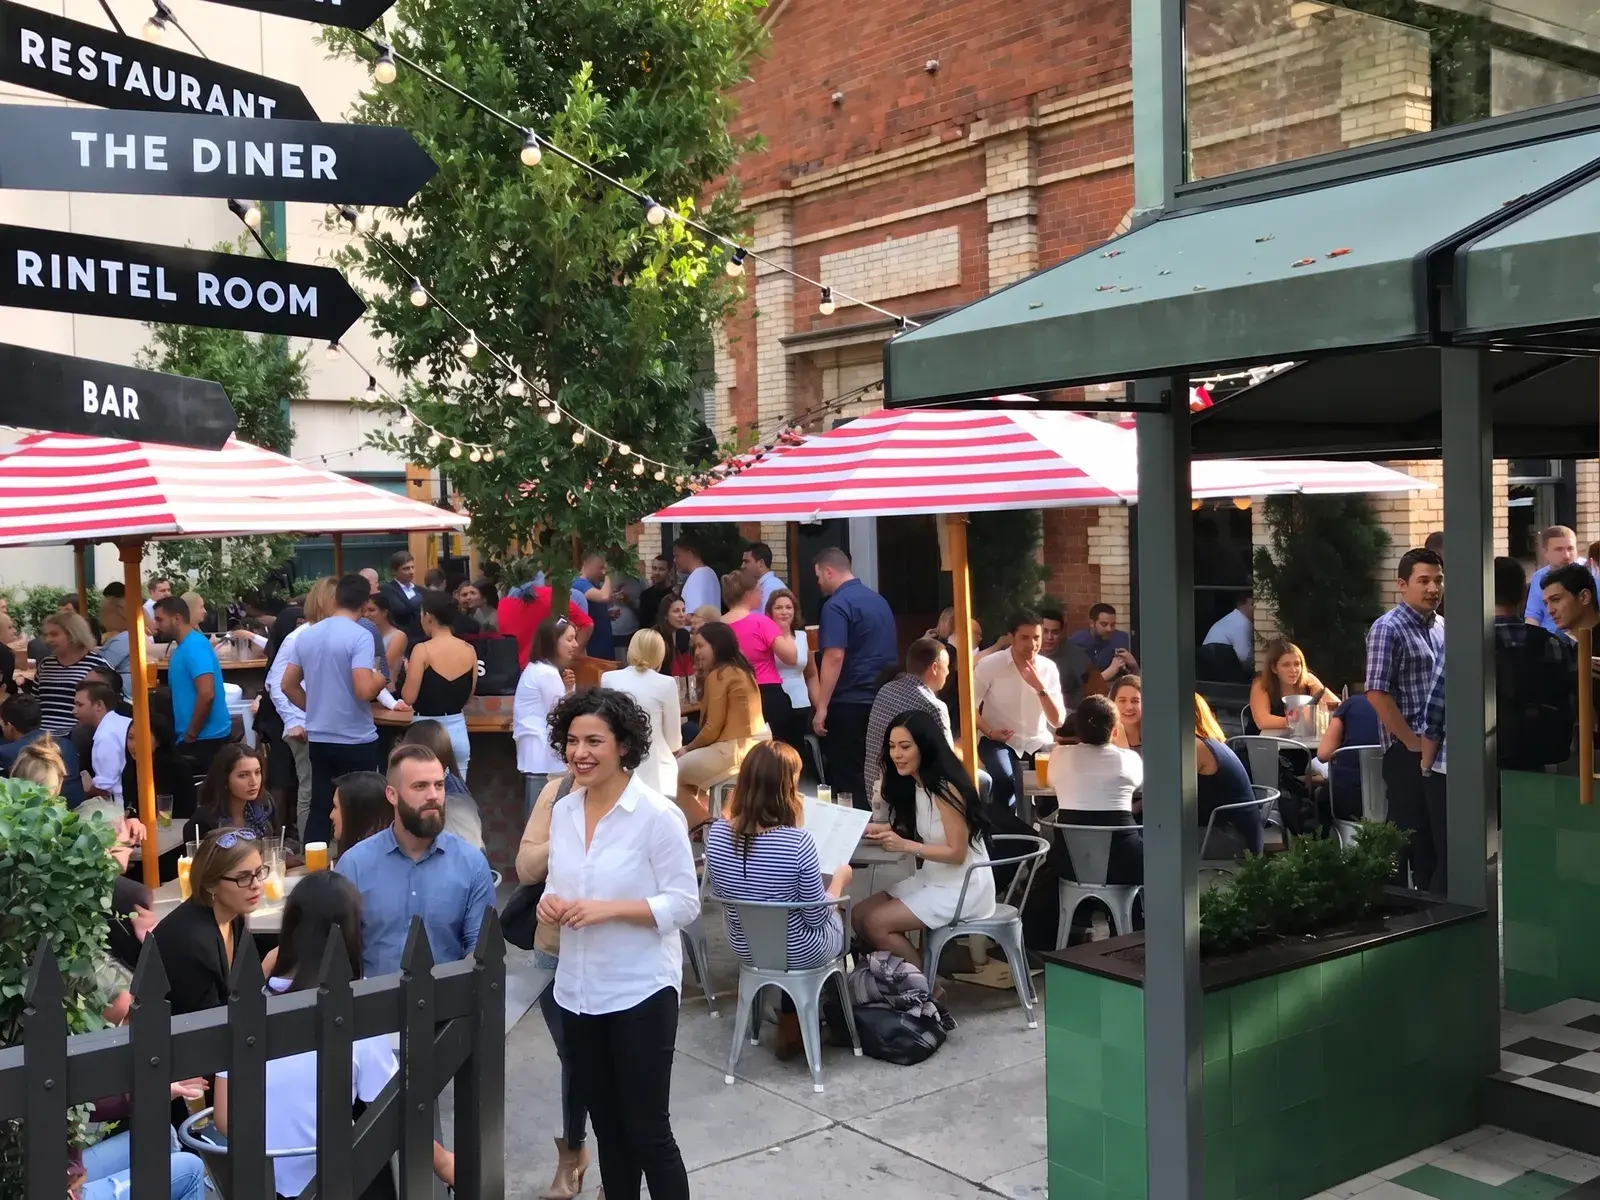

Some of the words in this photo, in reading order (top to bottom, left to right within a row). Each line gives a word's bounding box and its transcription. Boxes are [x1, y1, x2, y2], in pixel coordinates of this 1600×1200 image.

[20, 28, 277, 119] RESTAURANT
[70, 130, 169, 171] THE
[192, 137, 339, 181] DINER
[17, 249, 177, 302] RINTEL
[197, 271, 319, 318] ROOM
[82, 379, 141, 421] BAR
